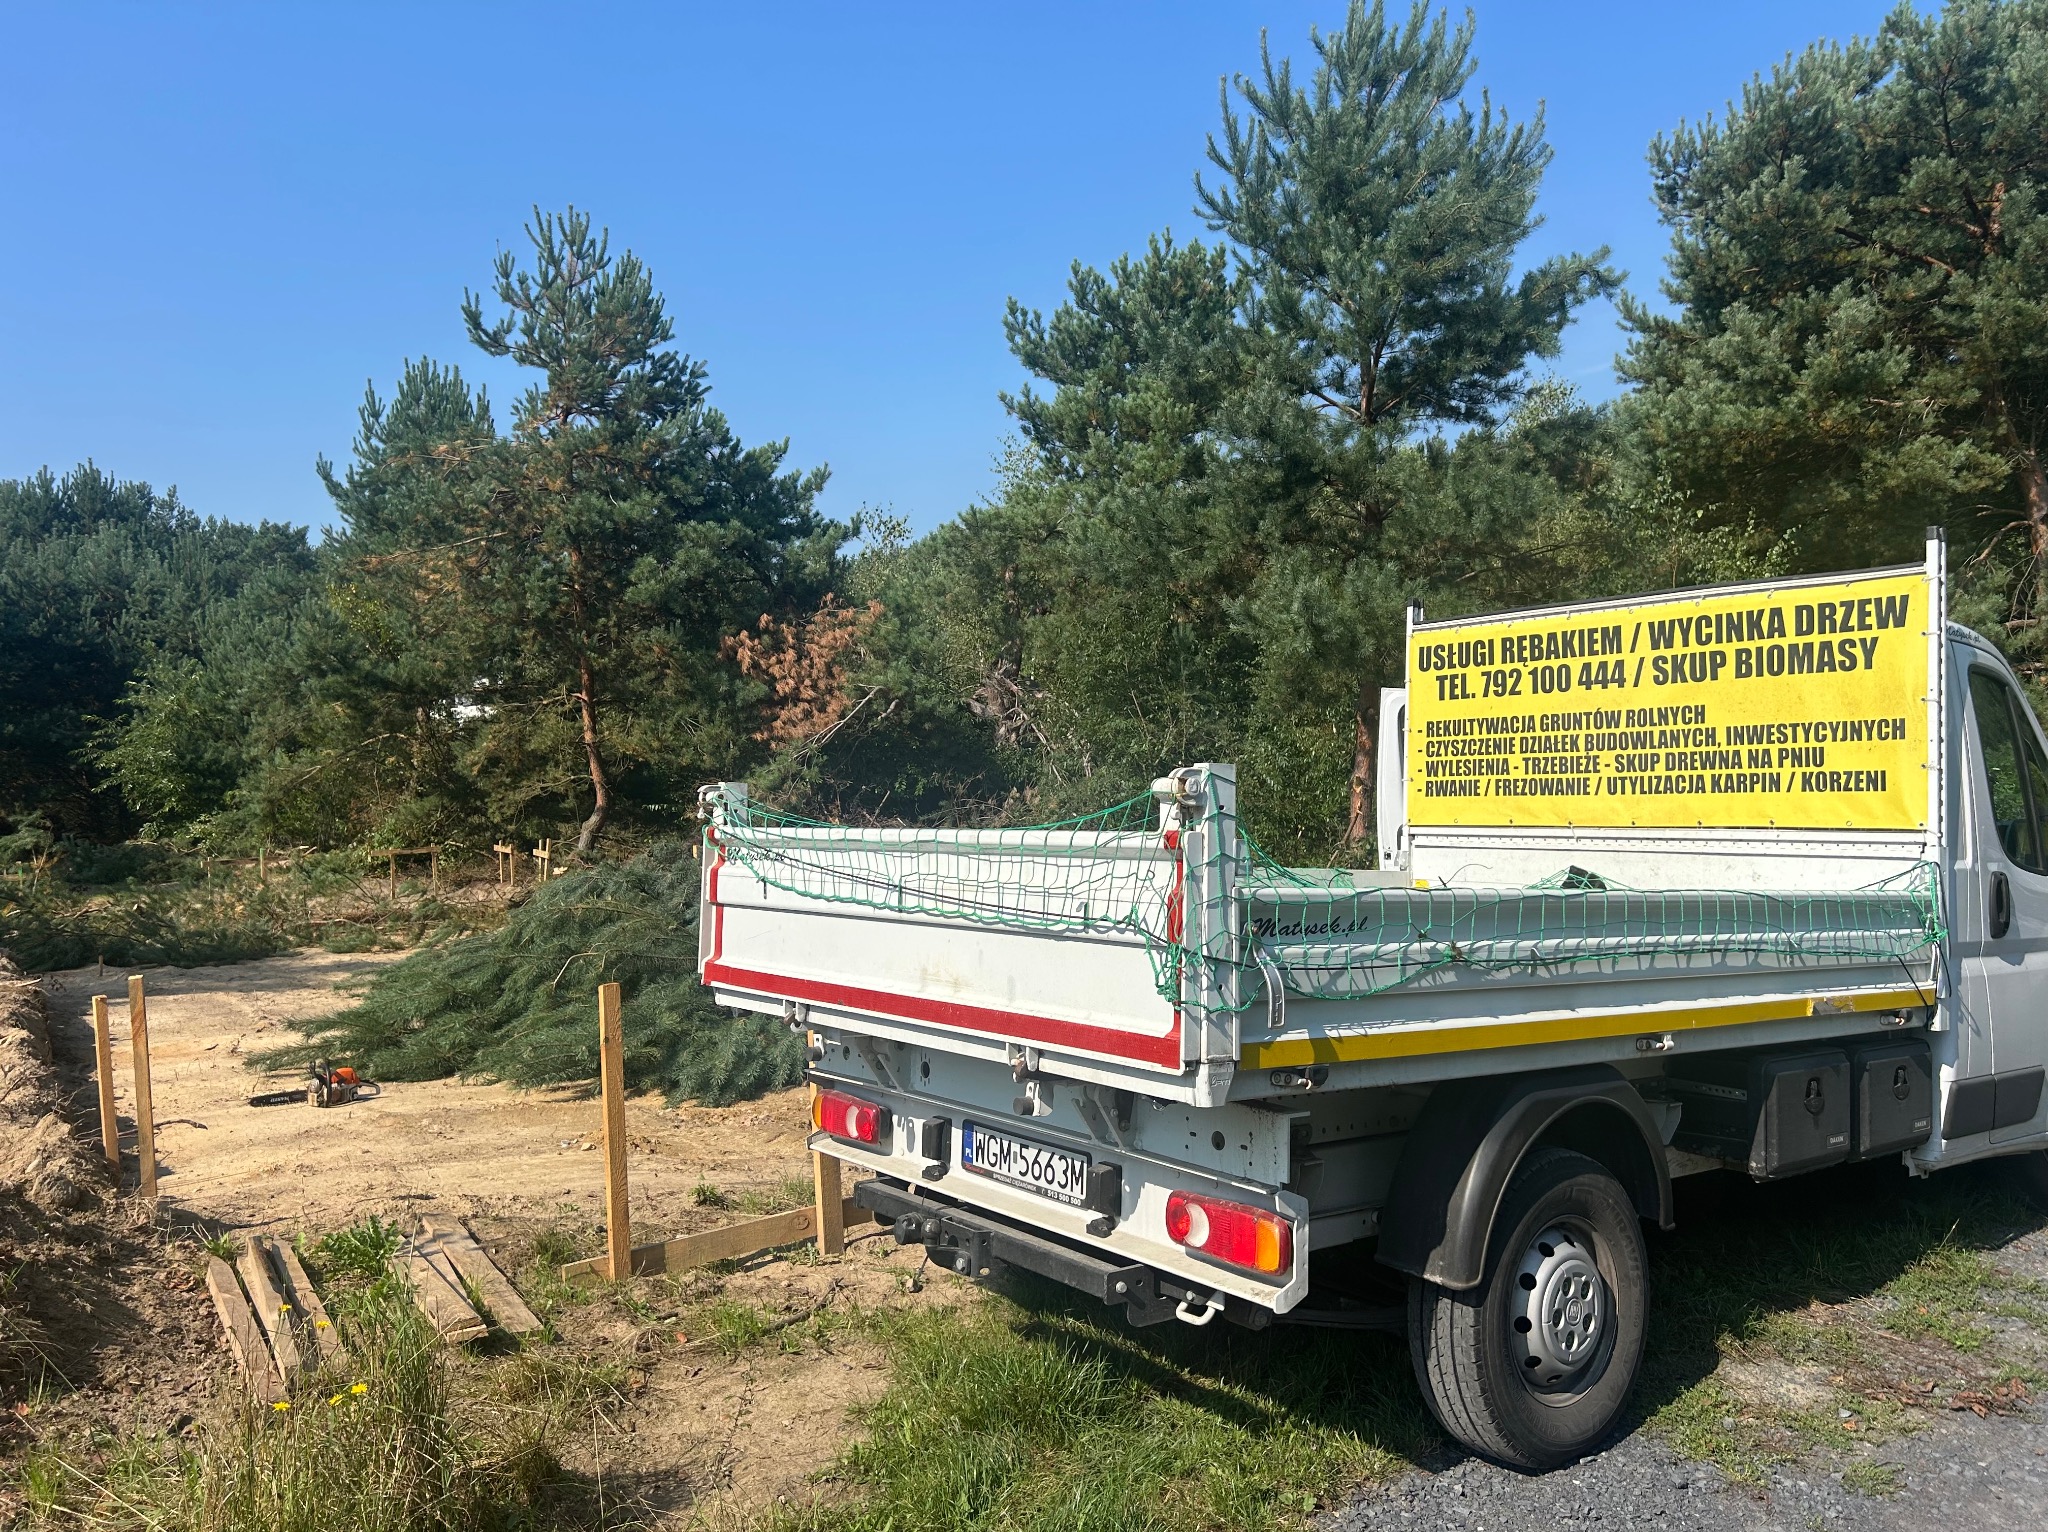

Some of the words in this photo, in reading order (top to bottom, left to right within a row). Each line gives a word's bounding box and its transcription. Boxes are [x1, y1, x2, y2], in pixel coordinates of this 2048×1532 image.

[1418, 638, 1495, 672] USŁUGI
[1500, 624, 1622, 667] RĘBAKIEM
[1629, 622, 1642, 653] /
[1648, 607, 1786, 651] WYCINKA
[1794, 594, 1910, 637] DRZEW
[1436, 672, 1476, 702] TEL.
[1481, 668, 1522, 698] 792
[1528, 664, 1571, 694] 100
[1577, 659, 1626, 691] 444
[1633, 657, 1645, 688] /
[1652, 650, 1727, 686] SKUP
[1734, 636, 1879, 679] BIOMASY
[1426, 714, 1535, 738] REKULTYWACJA
[1539, 707, 1622, 732] GRUNTÓW
[1625, 704, 1706, 728] ROLNYCH
[1425, 736, 1516, 758] CZYSZCZENIE
[1519, 733, 1580, 754] DZIAŁEK
[1584, 726, 1722, 752] BUDOWLANYCH,
[1726, 717, 1906, 746] INWESTYCYJNYCH
[1425, 757, 1510, 777] WYLESIENIA
[1522, 751, 1601, 775] TRZEBIEŻE
[1614, 752, 1661, 773] SKUP
[1665, 749, 1743, 771] DREWNA
[1747, 748, 1773, 769] NA
[1777, 746, 1825, 768] PNIU
[1425, 779, 1481, 797] RWANIE
[1484, 779, 1491, 797] /
[1495, 777, 1591, 797] FREZOWANIE
[1594, 777, 1602, 796] /
[1606, 774, 1706, 796] UTYLIZACJA
[1710, 772, 1781, 794] KARPIN
[1786, 771, 1795, 793] /
[1800, 770, 1887, 792] KORZENI
[1252, 916, 1369, 939] Matysek.pl
[965, 1147, 973, 1158] PL
[975, 1130, 1012, 1173] WGM
[1018, 1143, 1085, 1195] 5663M
[1047, 1189, 1058, 1199] 513
[1058, 1192, 1070, 1203] 500
[1070, 1195, 1082, 1206] 500
